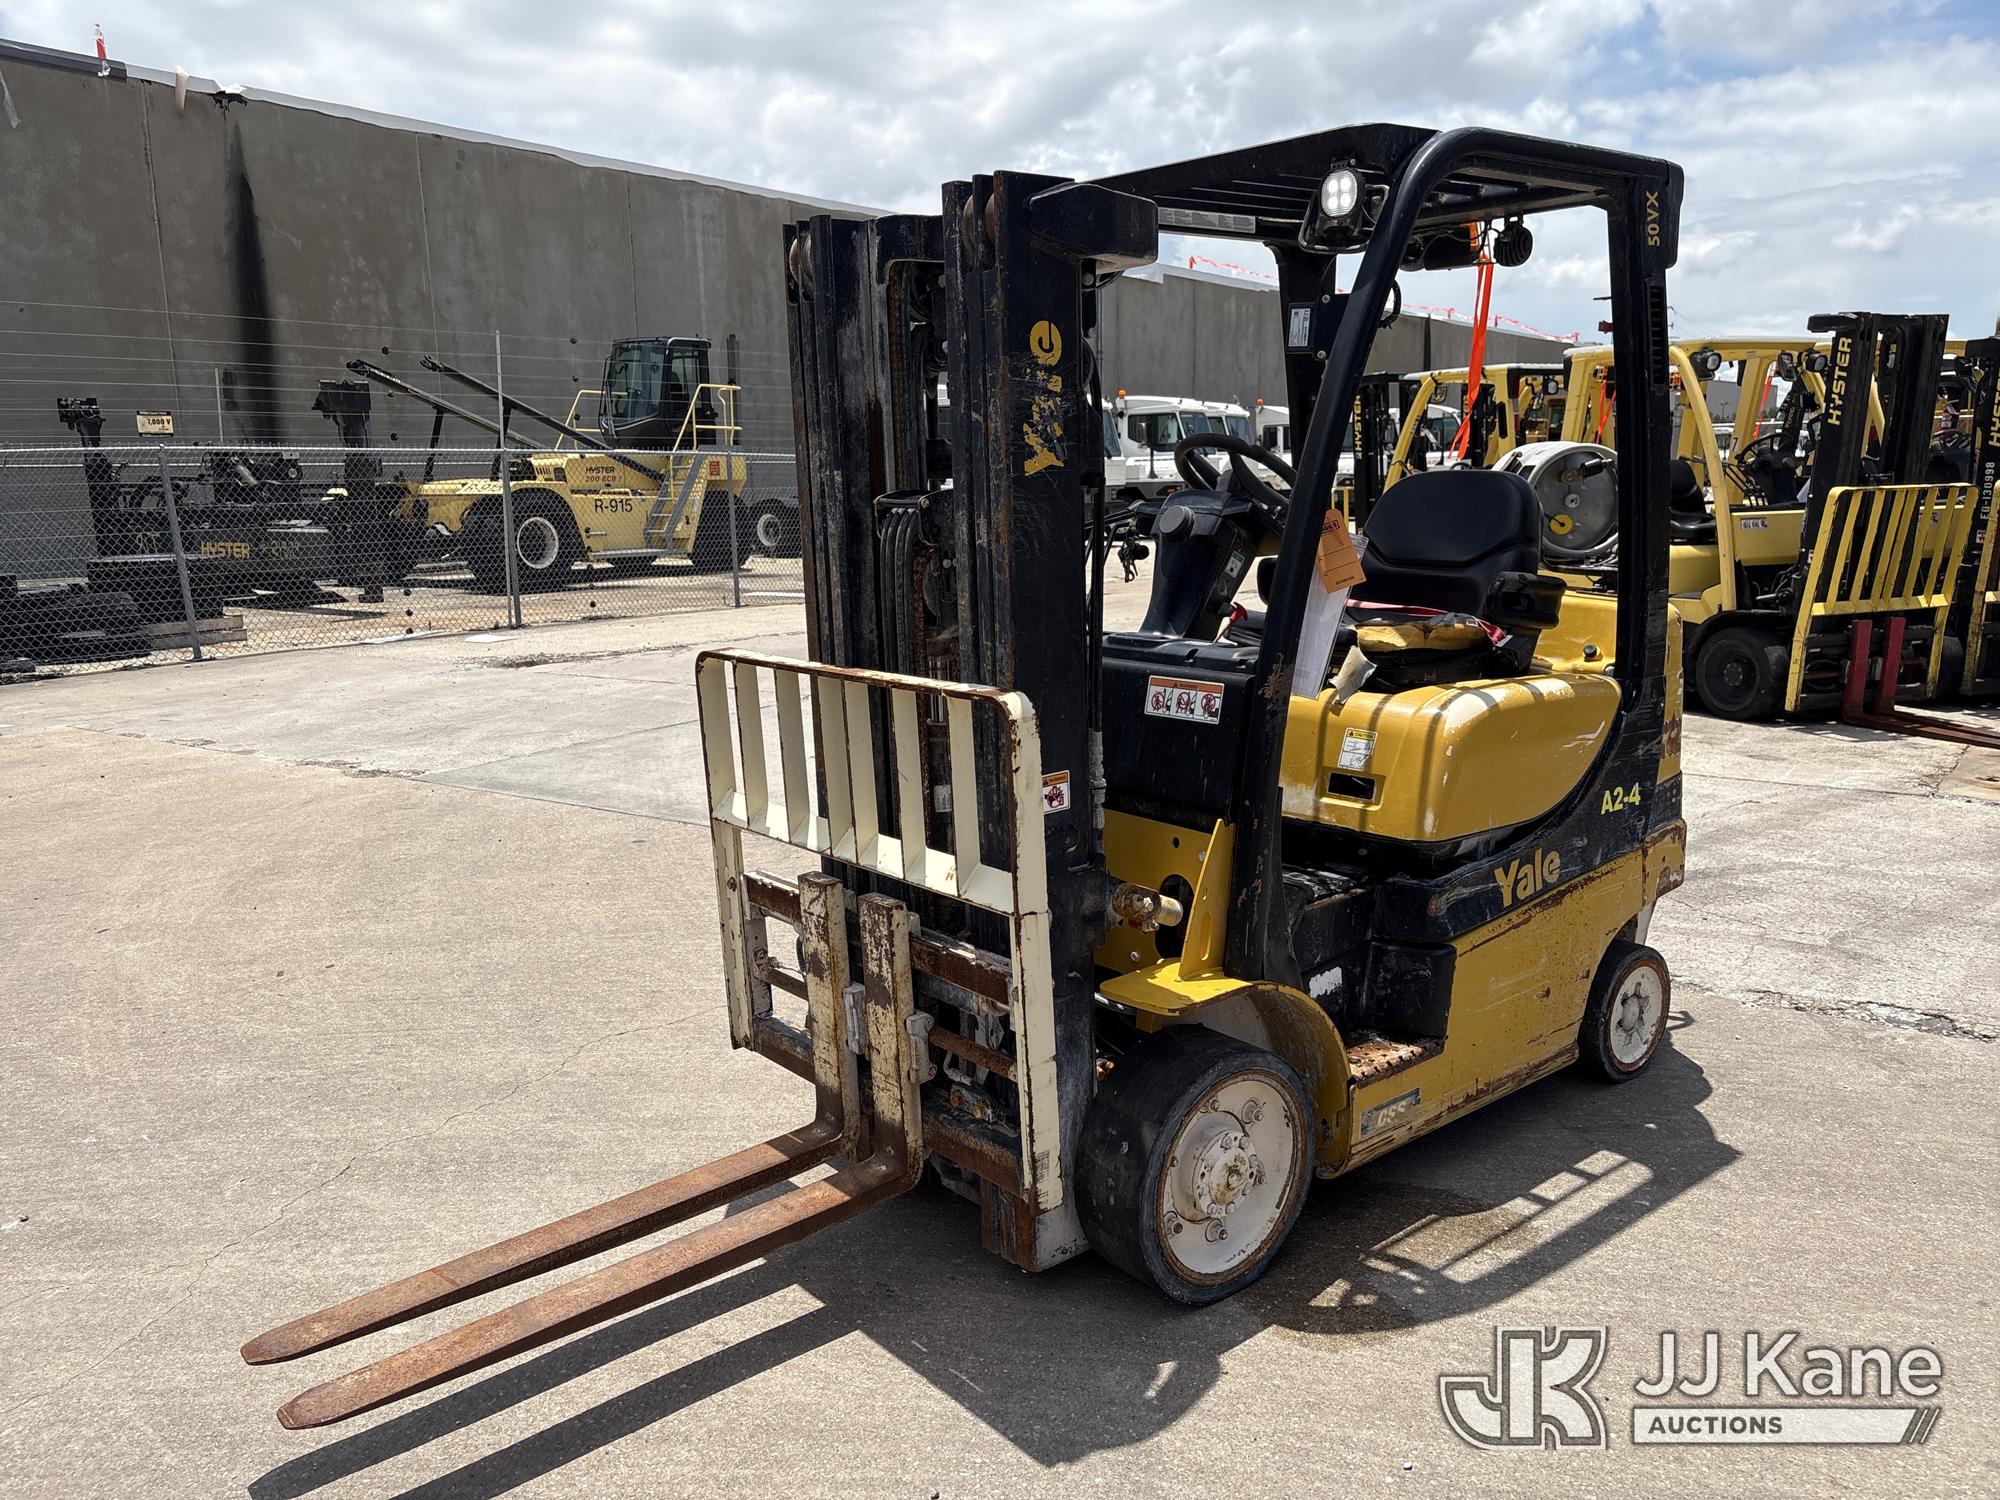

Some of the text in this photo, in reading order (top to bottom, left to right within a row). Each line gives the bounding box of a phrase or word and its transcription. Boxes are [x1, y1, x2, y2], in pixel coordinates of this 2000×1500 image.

[1646, 191, 1660, 247] 50VX
[1828, 336, 1852, 426] HYSTER
[1989, 368, 2000, 447] HYS
[585, 466, 615, 474] HYSTER
[594, 499, 633, 513] R-915
[202, 541, 249, 558] HYSTER
[1600, 782, 1641, 815] A2-4
[1494, 848, 1561, 908] Yale
